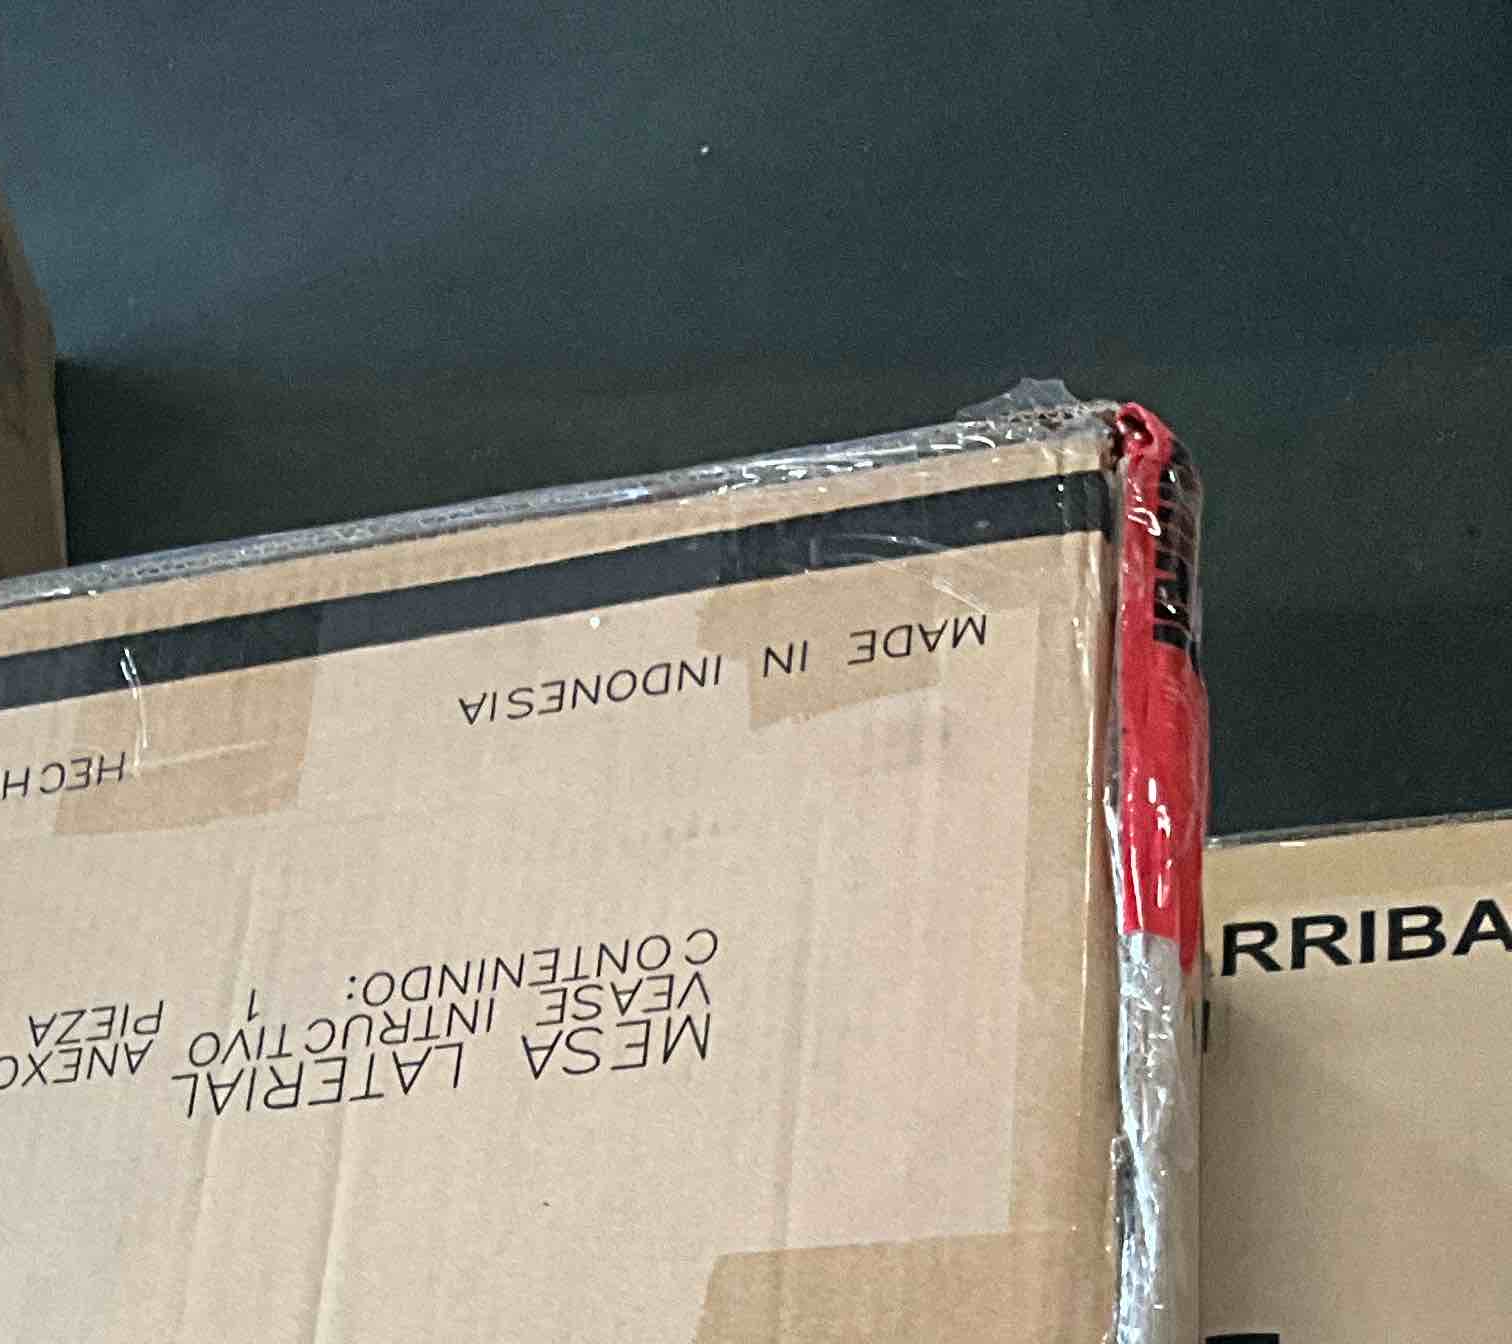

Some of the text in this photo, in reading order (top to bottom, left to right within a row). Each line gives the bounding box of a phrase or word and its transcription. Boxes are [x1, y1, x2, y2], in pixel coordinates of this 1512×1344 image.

[458, 614, 988, 725] MADE IN INDONESIA
[29, 927, 719, 1045] CONTENINDO: 1 PIEZA
[189, 998, 495, 1066] INTRUCTIVO
[536, 972, 711, 1028] VEASE
[171, 1013, 712, 1119] MESA LATERIAL
